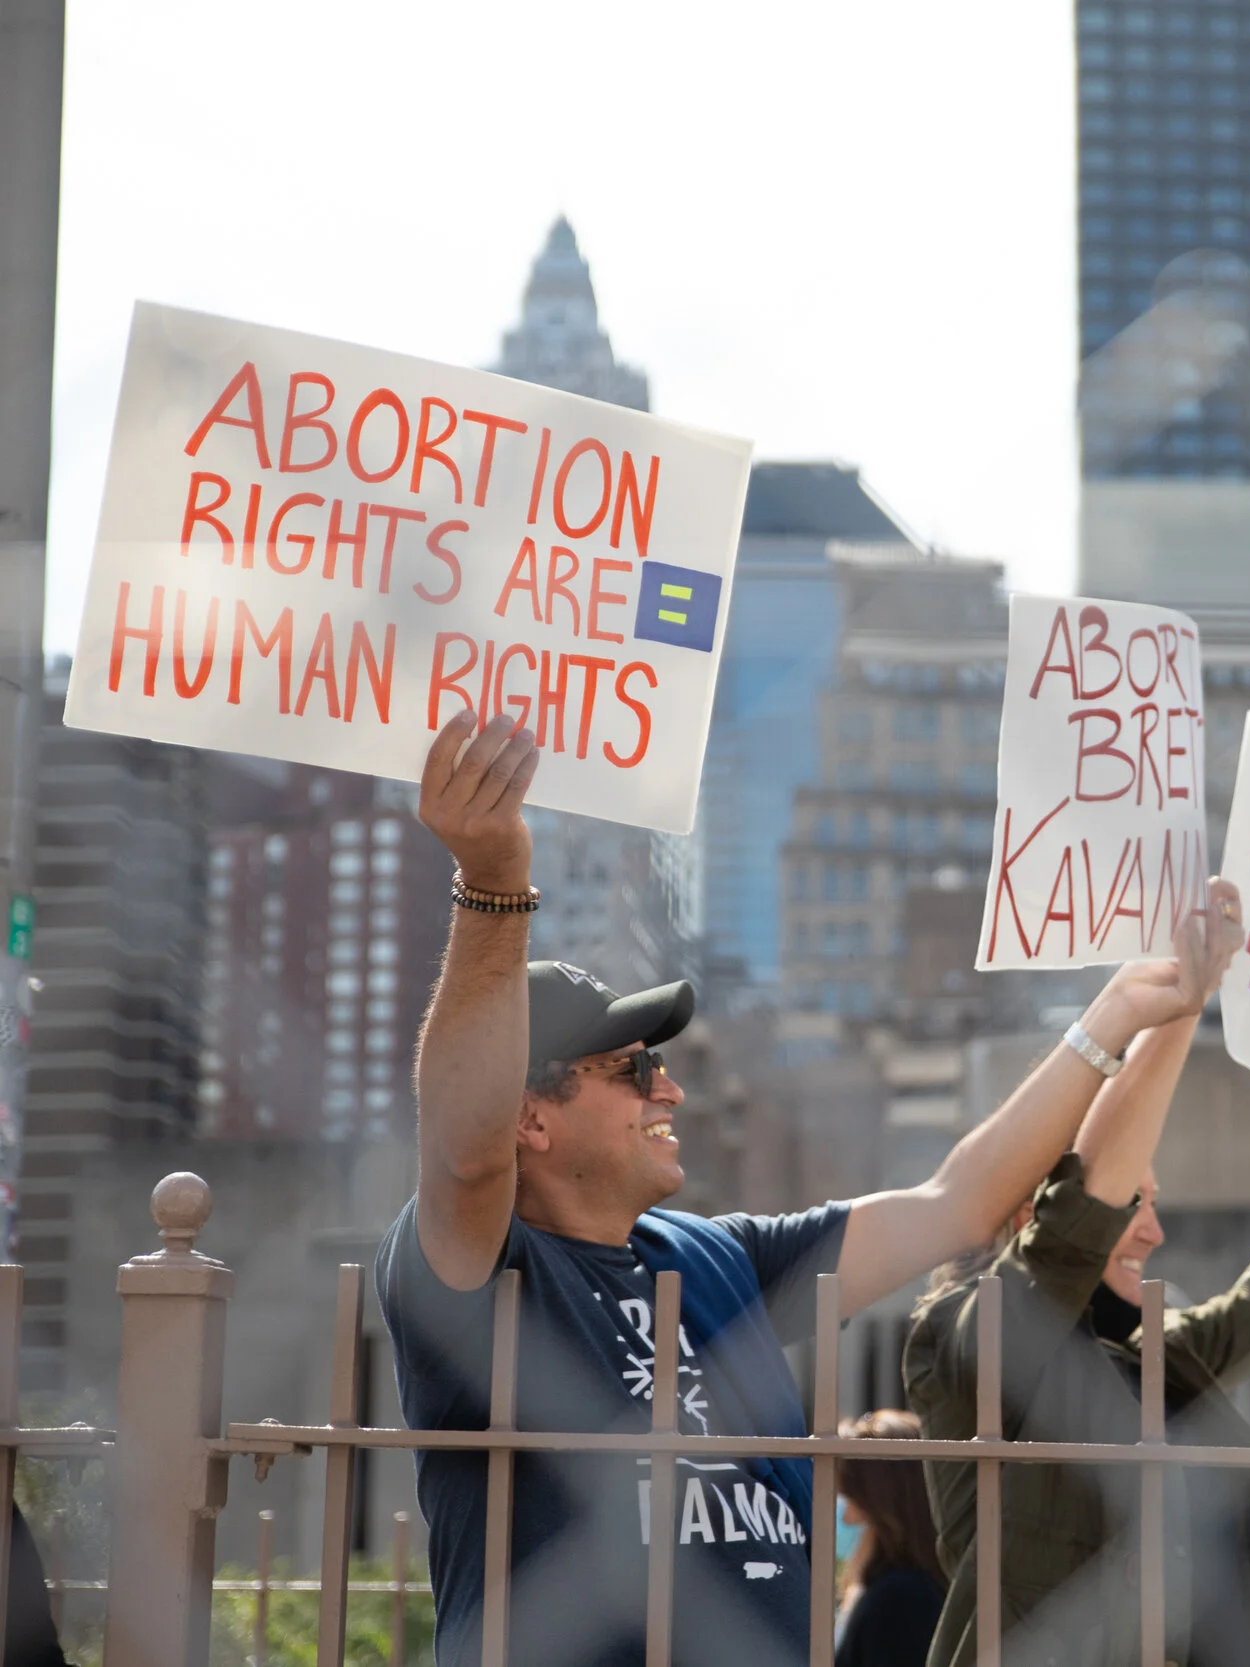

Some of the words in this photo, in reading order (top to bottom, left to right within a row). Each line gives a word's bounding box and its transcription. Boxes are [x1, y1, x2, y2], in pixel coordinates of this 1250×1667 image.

[184, 361, 660, 557] ABORTION
[181, 472, 470, 604] RIGHTS
[494, 537, 633, 643] ARE
[109, 582, 397, 724] HUMAN
[428, 632, 658, 768] RIGHTS
[1029, 605, 1196, 701] ABORT
[1068, 702, 1204, 811] BRET
